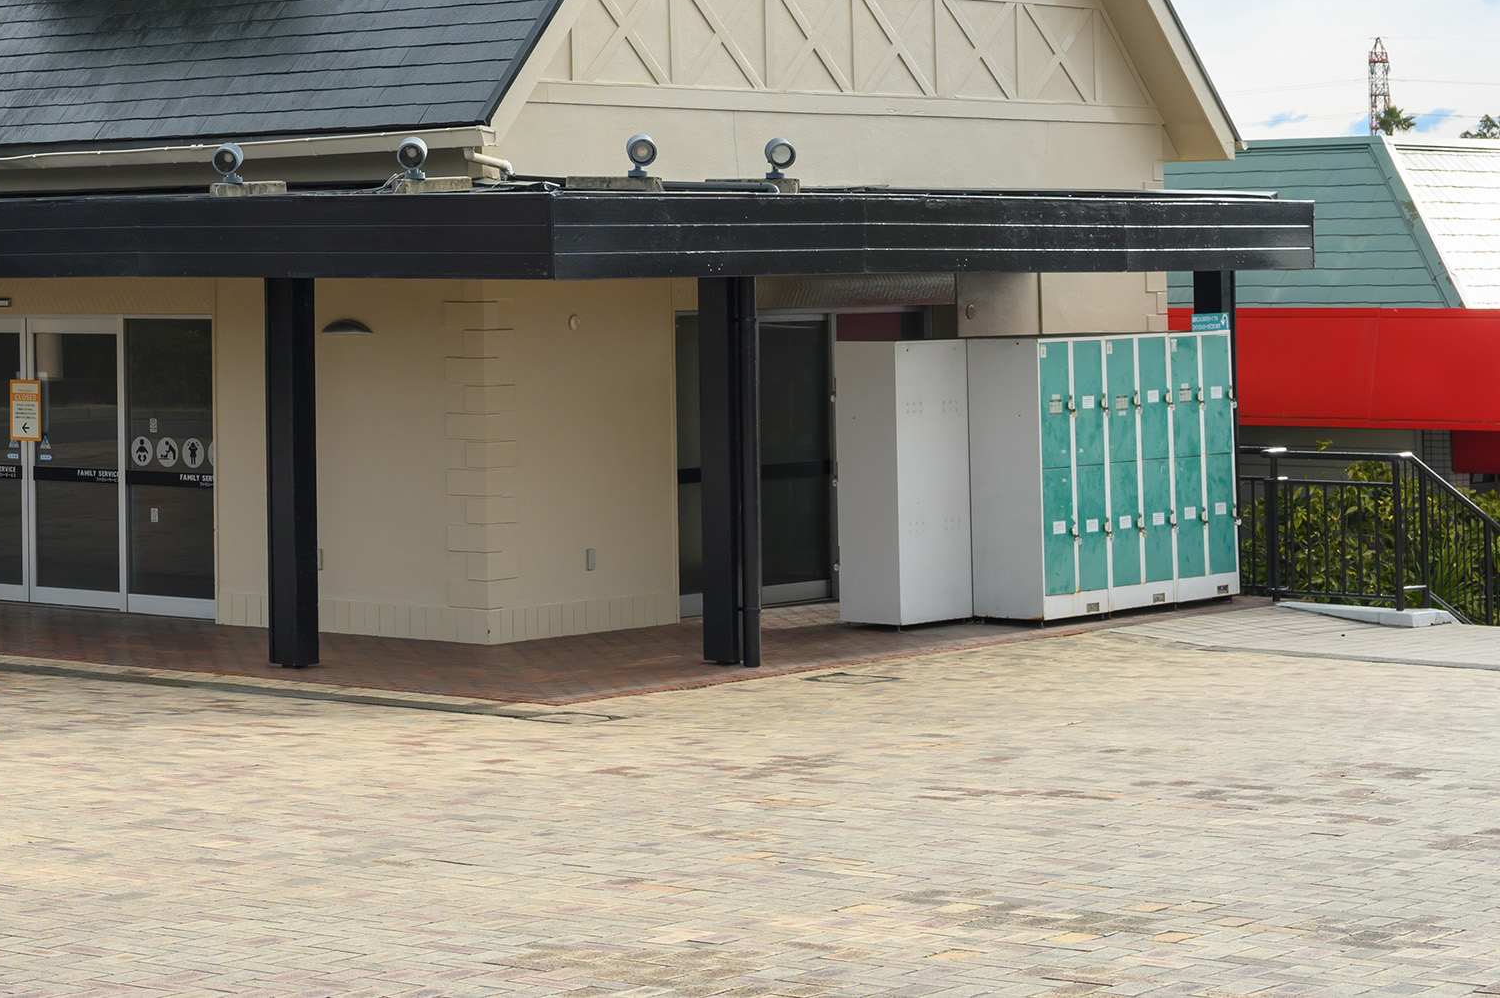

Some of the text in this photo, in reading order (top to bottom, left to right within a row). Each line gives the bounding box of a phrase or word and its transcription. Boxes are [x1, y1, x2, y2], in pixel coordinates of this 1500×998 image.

[14, 393, 37, 401] CLOSED
[77, 469, 96, 477] FAMILY
[180, 473, 200, 482] FAMILY
